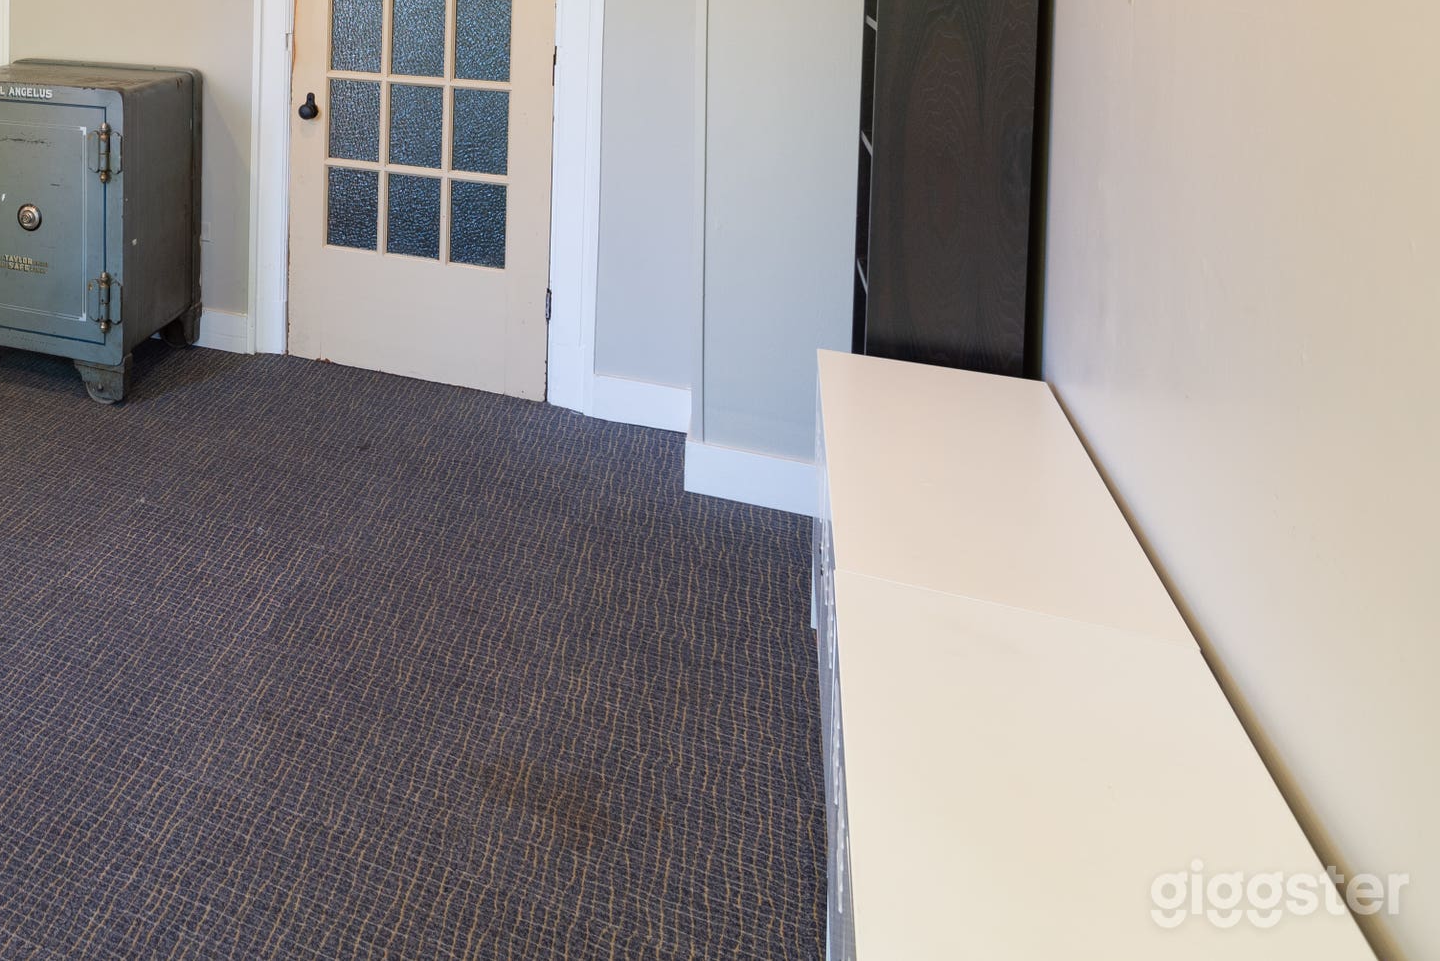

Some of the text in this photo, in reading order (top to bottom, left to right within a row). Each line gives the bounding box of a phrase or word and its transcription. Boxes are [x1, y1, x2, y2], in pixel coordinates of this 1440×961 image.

[8, 86, 53, 99] ANGELUS
[4, 254, 33, 265] TAYLOR
[8, 262, 31, 272] SAFE
